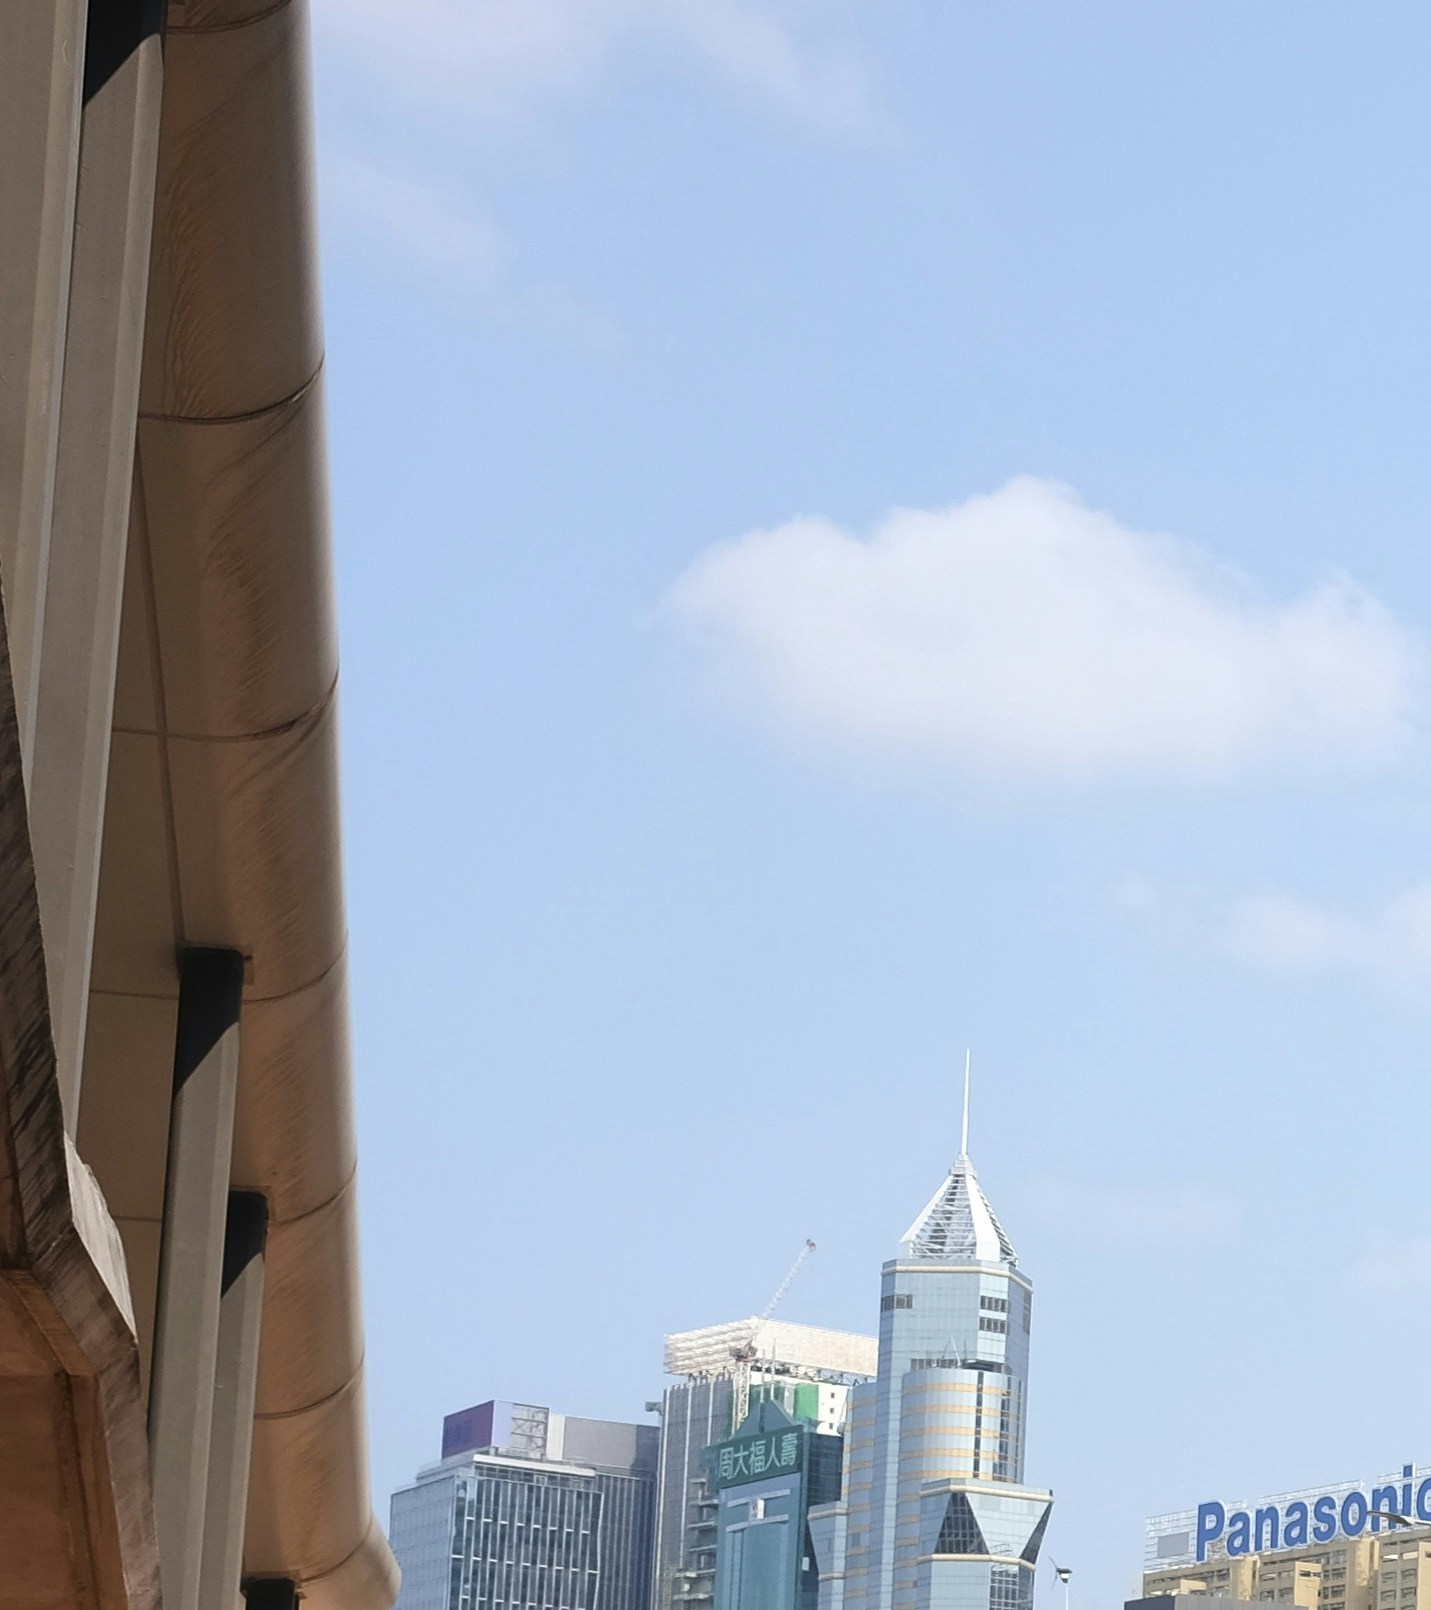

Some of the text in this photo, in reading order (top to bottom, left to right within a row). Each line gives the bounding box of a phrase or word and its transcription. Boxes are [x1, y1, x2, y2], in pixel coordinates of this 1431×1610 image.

[720, 1432, 798, 1479] 周大福人壽
